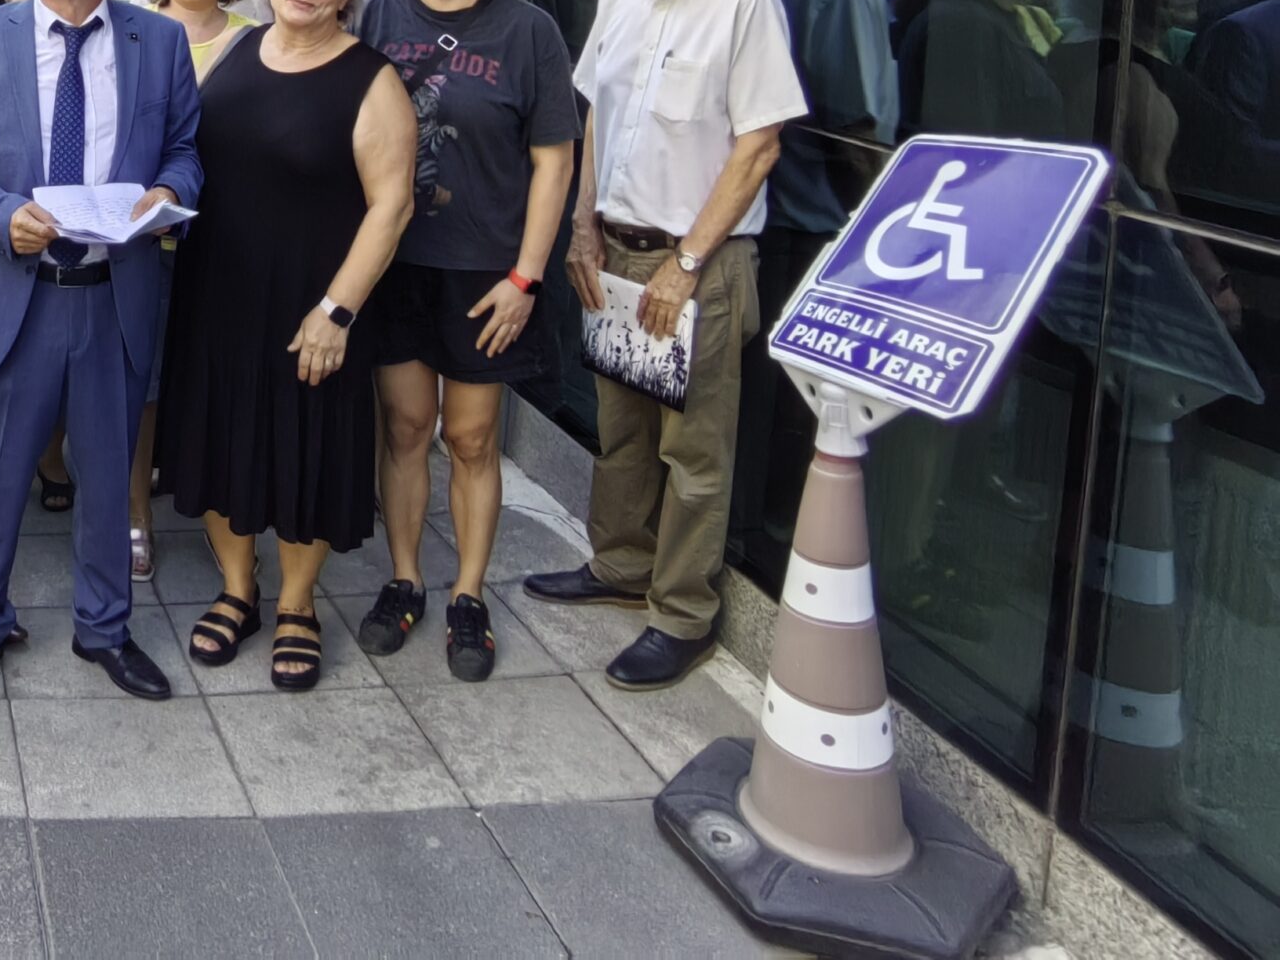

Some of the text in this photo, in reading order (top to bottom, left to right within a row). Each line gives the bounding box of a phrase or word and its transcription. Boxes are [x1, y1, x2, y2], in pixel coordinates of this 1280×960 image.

[786, 323, 948, 396] PARK YERİ
[801, 302, 968, 372] ENGELLİ ARAÇ
